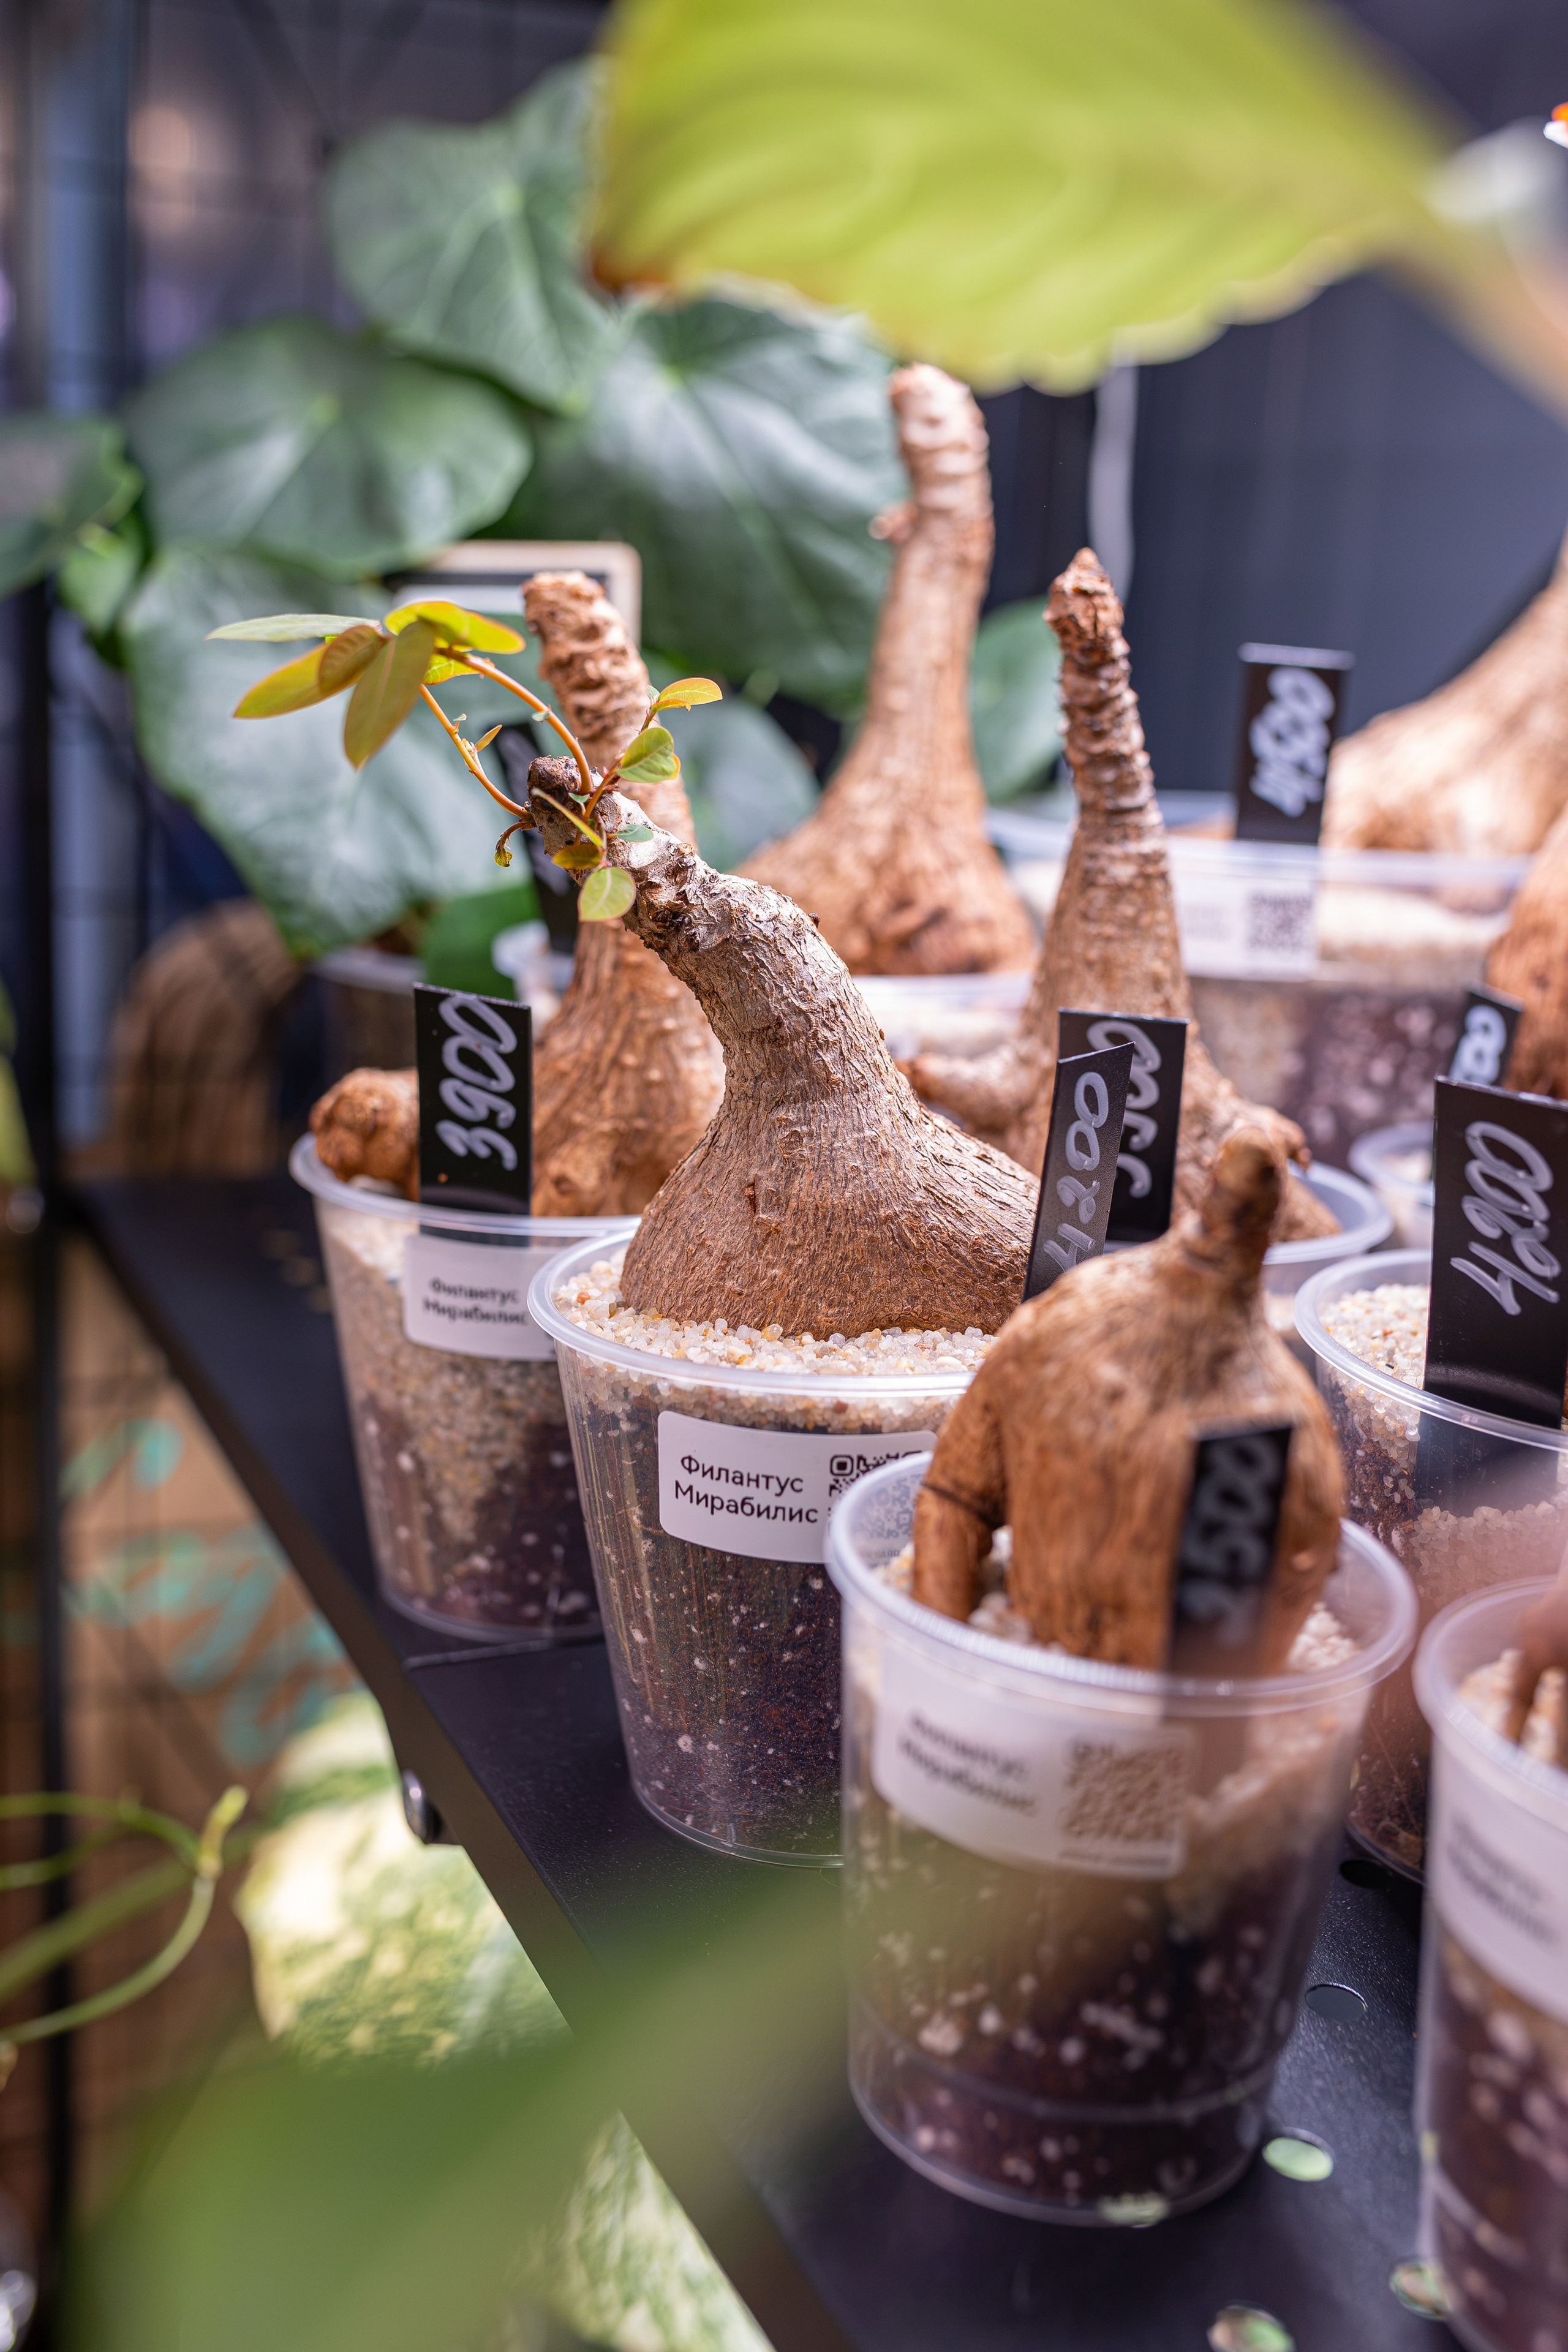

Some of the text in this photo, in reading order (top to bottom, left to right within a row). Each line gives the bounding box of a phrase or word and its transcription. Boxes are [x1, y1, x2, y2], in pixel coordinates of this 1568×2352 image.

[435, 994, 518, 1171] 3900
[1043, 1071, 1109, 1273] 4200
[1450, 1120, 1562, 1316] 4200
[674, 1479, 818, 1524] Мирабилис
[680, 1455, 804, 1497] Филантус
